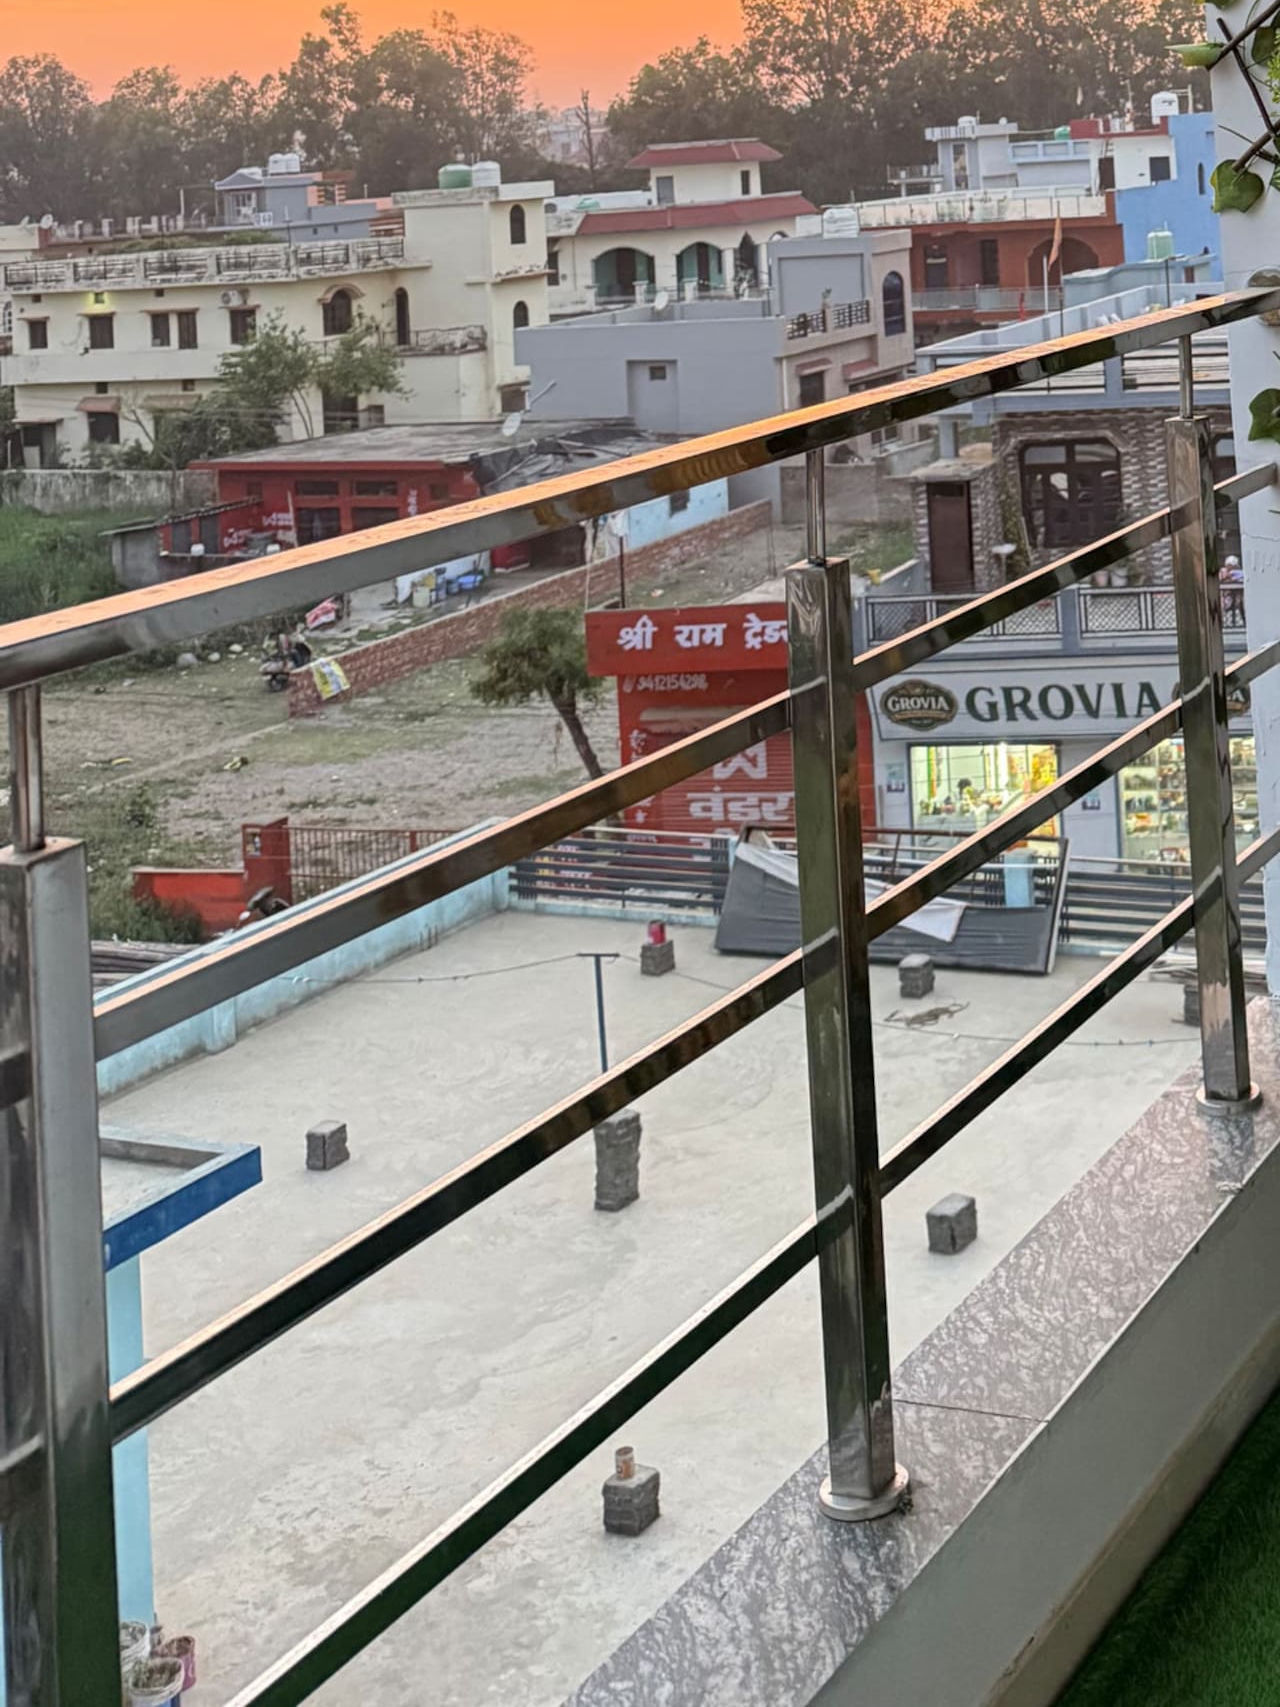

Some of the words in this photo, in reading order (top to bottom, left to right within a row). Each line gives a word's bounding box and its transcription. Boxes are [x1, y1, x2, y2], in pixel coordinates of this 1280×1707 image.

[617, 614, 658, 650] श्री
[674, 622, 727, 649] राम
[743, 613, 789, 650] ट्रेड
[887, 696, 950, 712] GROVIA
[965, 681, 1162, 722] GROVIA
